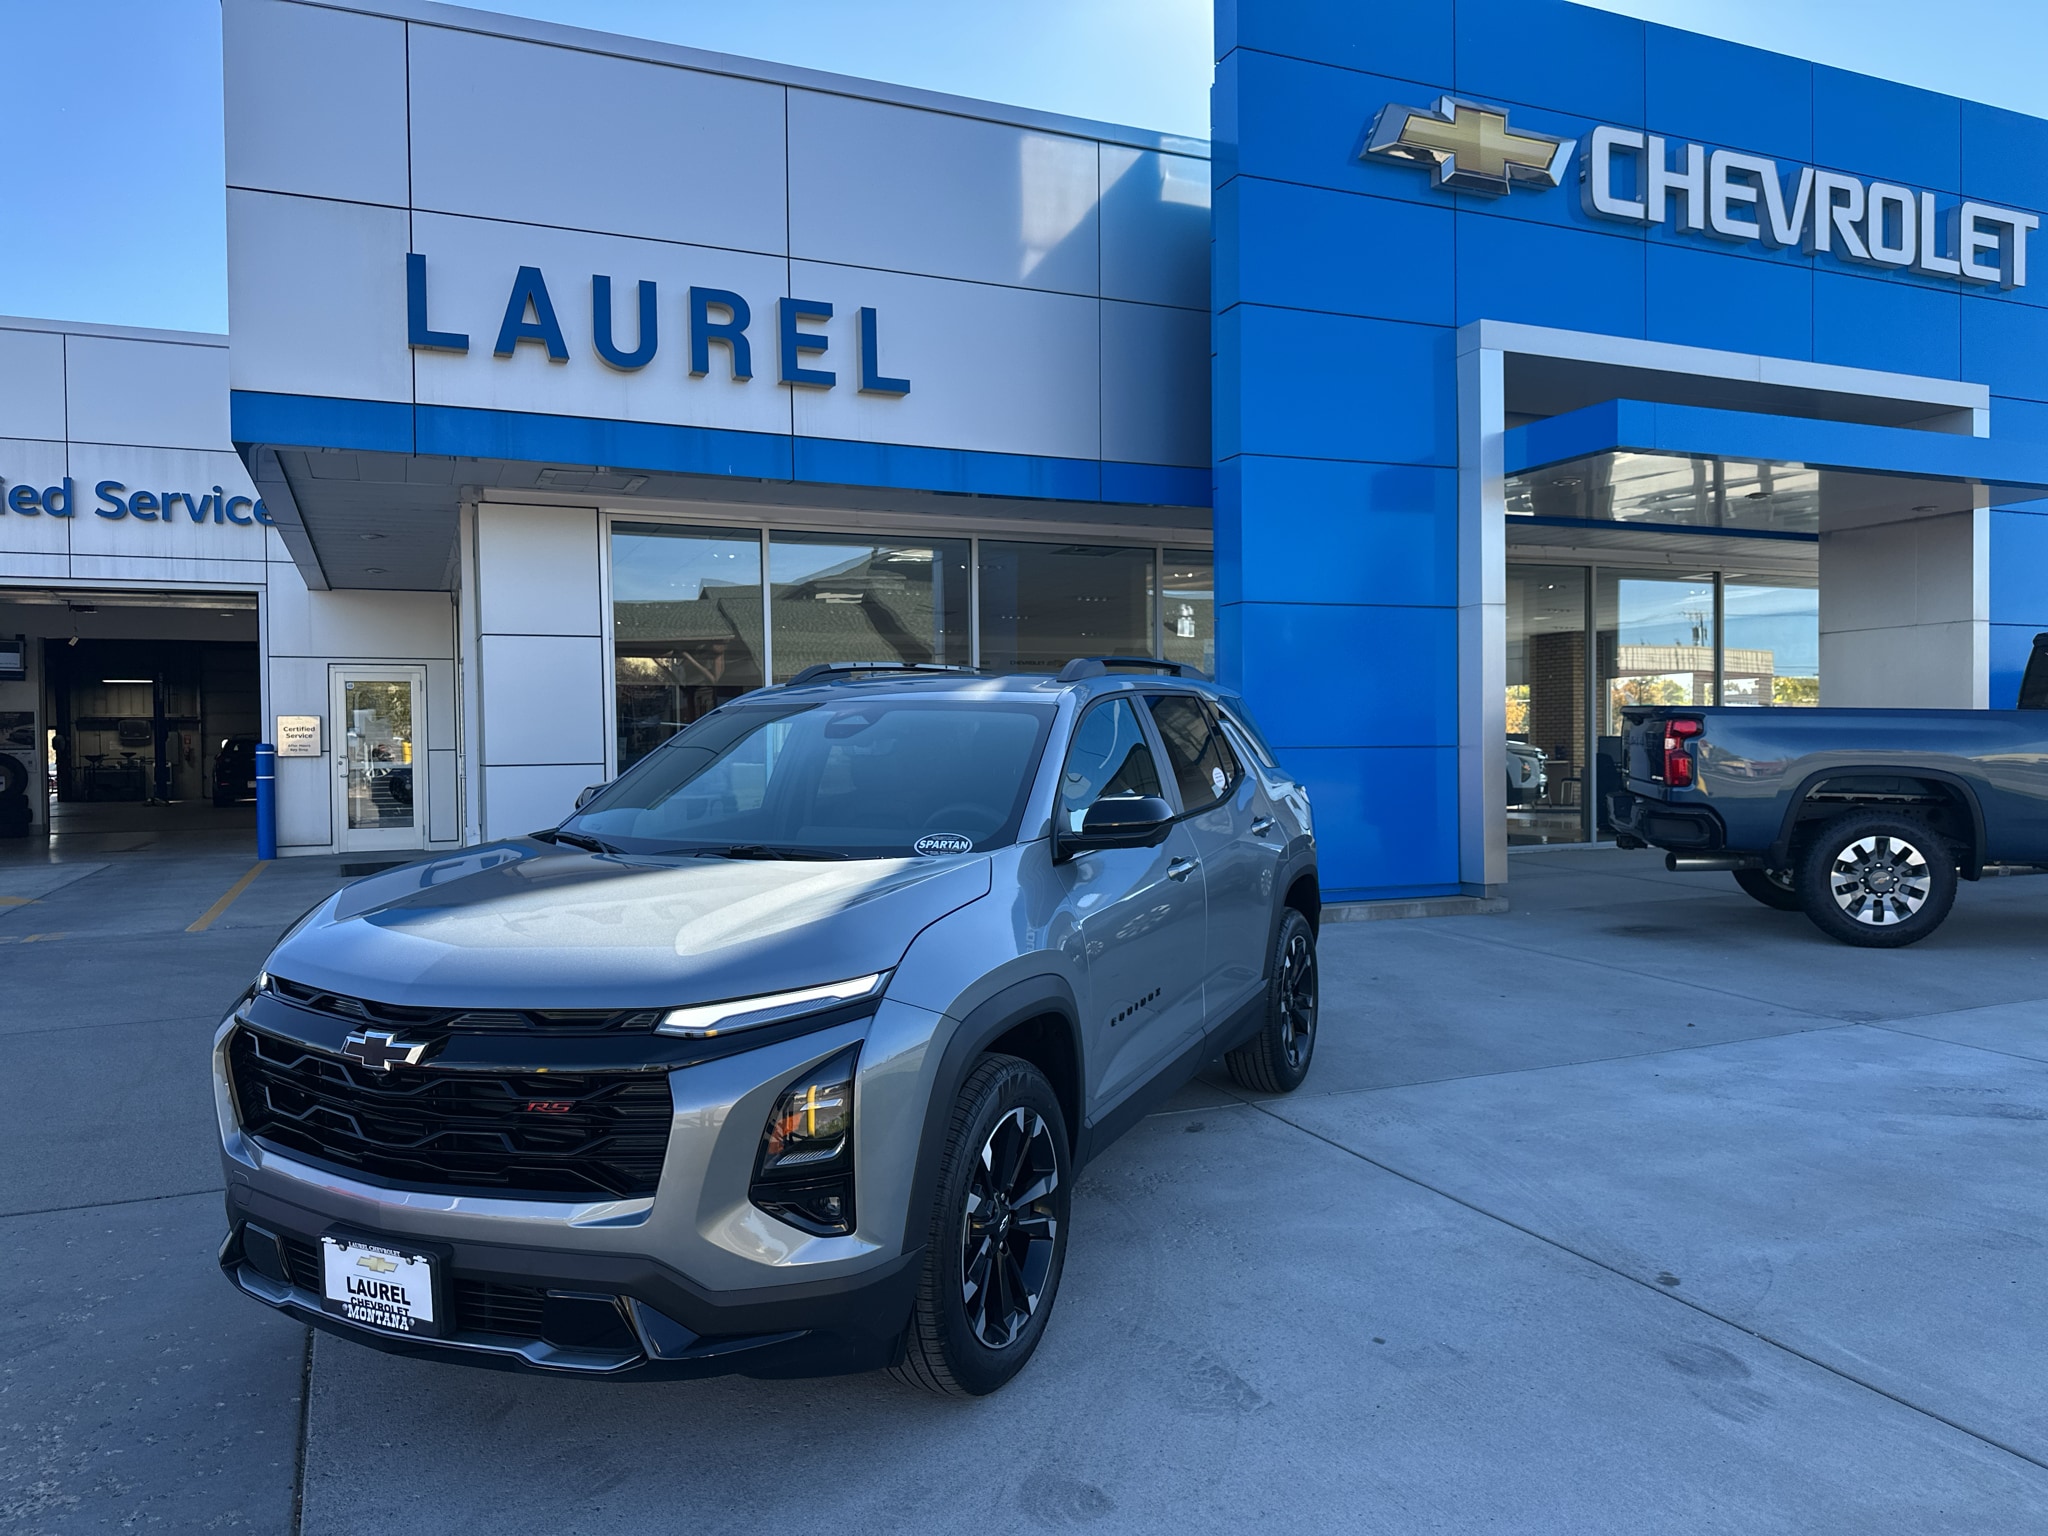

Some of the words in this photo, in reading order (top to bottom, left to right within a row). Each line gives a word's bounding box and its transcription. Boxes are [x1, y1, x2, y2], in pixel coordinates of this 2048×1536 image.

[1580, 125, 2040, 290] CHEVROLET
[406, 252, 911, 397] LAUREL
[918, 840, 969, 850] SPARTAN
[527, 1100, 572, 1113] RS
[348, 1241, 369, 1251] LAUREL
[369, 1245, 401, 1257] CHEVROLET
[346, 1276, 411, 1306] LAUREL
[347, 1304, 410, 1331] MONTANA
[350, 1297, 410, 1316] CHEVROLET
